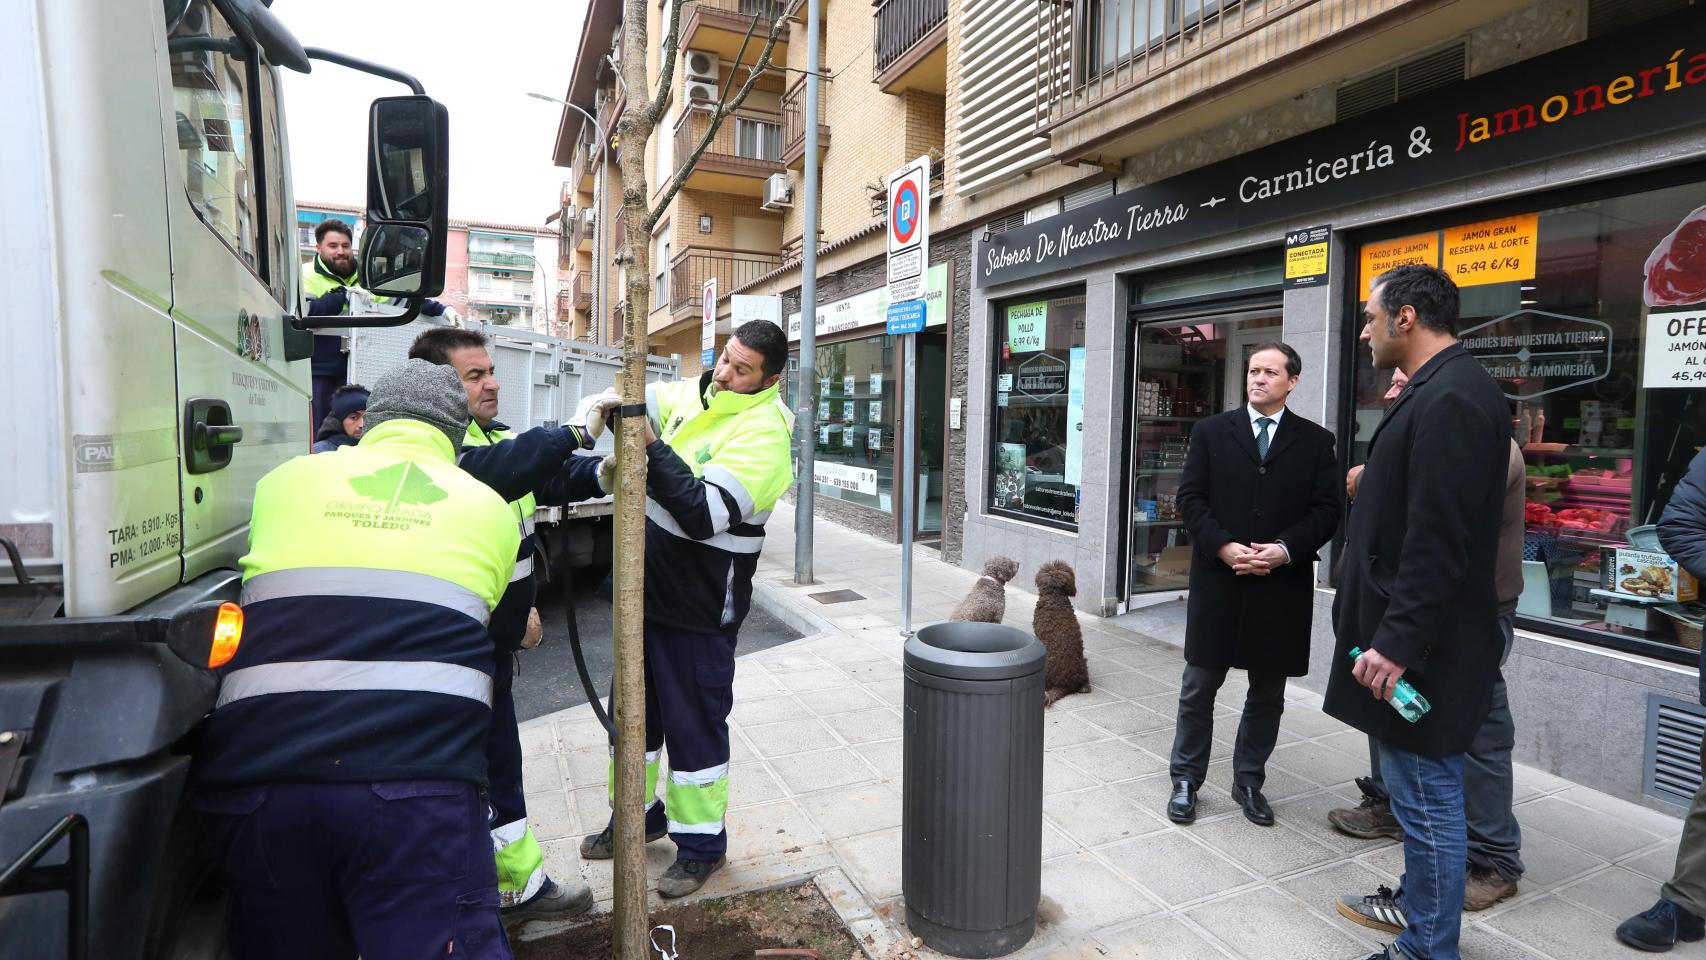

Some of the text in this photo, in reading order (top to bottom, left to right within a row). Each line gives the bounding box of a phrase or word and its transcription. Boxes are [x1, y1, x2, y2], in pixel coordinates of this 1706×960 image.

[986, 49, 1706, 276] Sabores De Nuestra Tierra Carnicería & Jamonería
[1493, 225, 1517, 236] GRAN
[1449, 236, 1530, 256] RESERVA AL CORTE
[1289, 248, 1324, 258] CONECTADA
[1369, 250, 1391, 260] TACOS
[1393, 248, 1402, 256] DE
[1372, 261, 1390, 271] GRAN
[1490, 257, 1520, 270] €/Kg
[1036, 306, 1044, 316] DE
[1018, 322, 1034, 333] POLLO
[1500, 335, 1513, 348] DE
[1514, 333, 1562, 347] NUESTRA
[1564, 330, 1606, 344] TIERRA
[1685, 356, 1699, 366] AL
[1530, 360, 1596, 377] JAMONERÍA
[324, 512, 370, 520] PARQUES
[384, 516, 431, 526] JARDINES
[352, 520, 410, 531] TOLEDO
[108, 524, 138, 545] TARA:
[110, 548, 136, 568] PMA:
